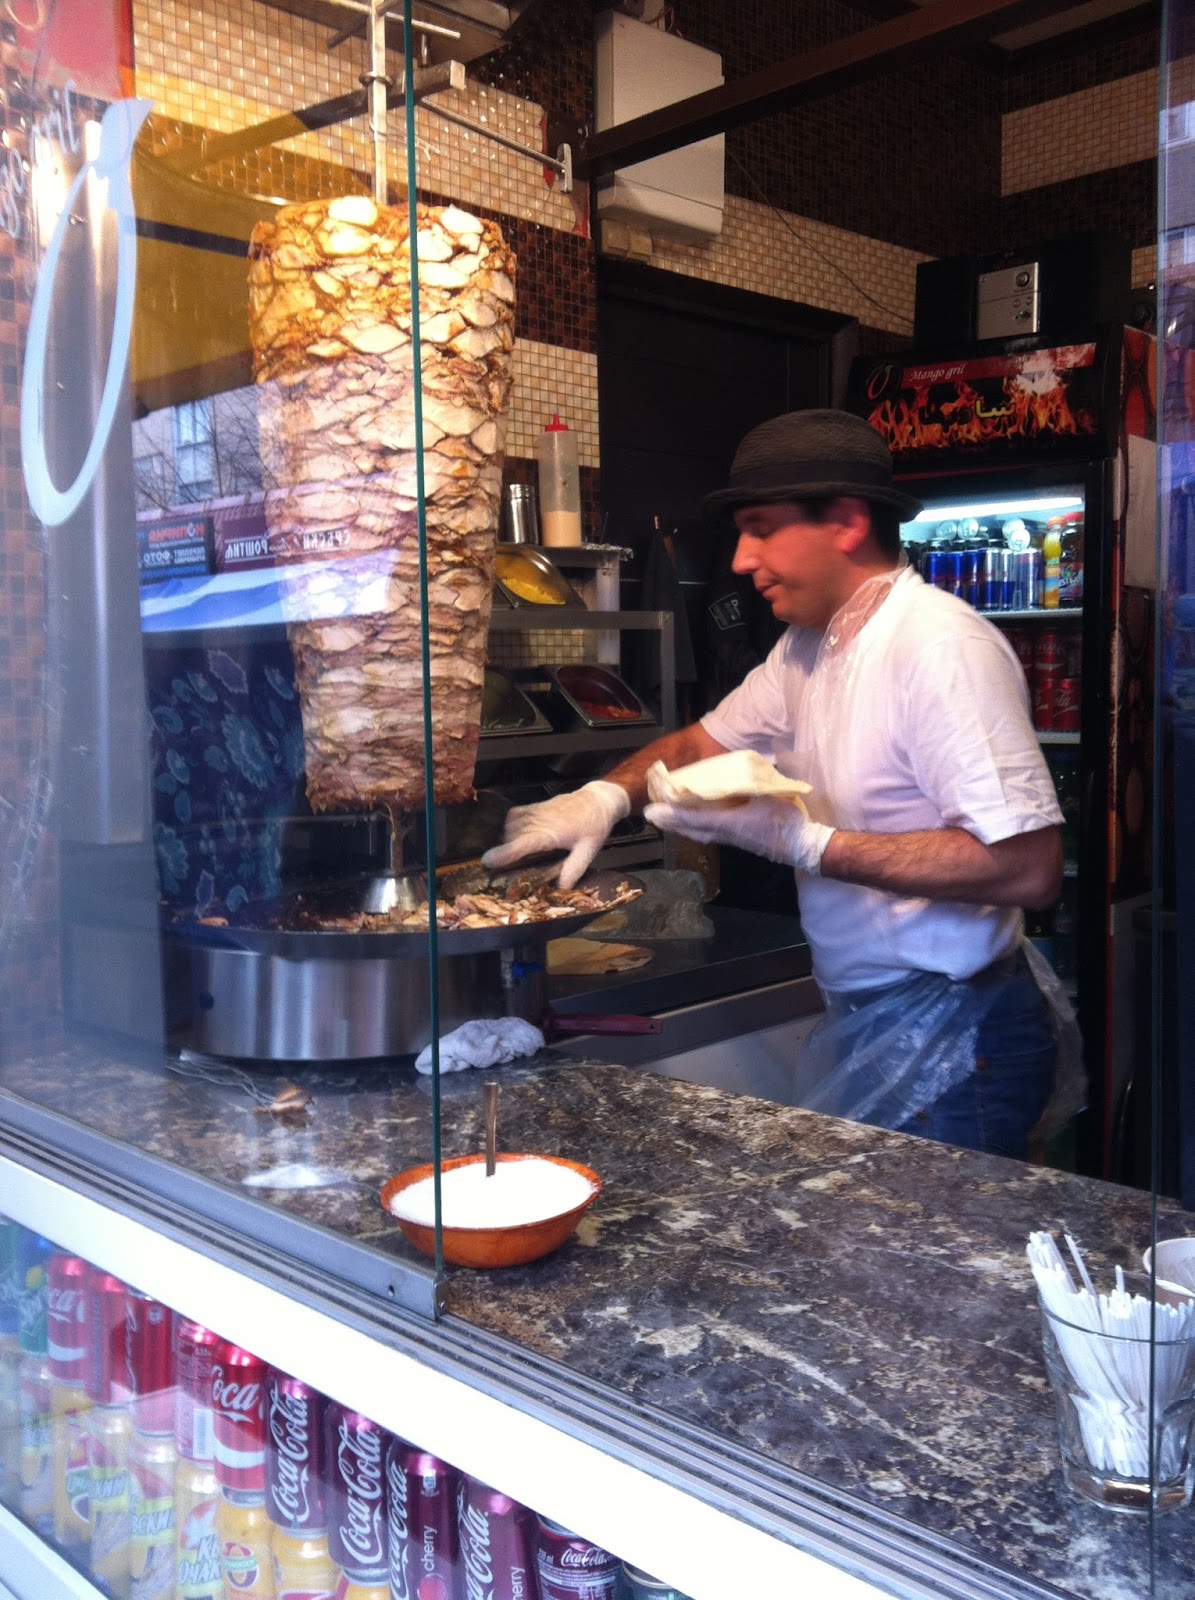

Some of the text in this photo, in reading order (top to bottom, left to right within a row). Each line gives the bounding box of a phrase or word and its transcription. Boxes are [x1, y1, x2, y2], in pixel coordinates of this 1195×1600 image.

[910, 363, 966, 382] Mango gril
[421, 1525, 438, 1572] cherry
